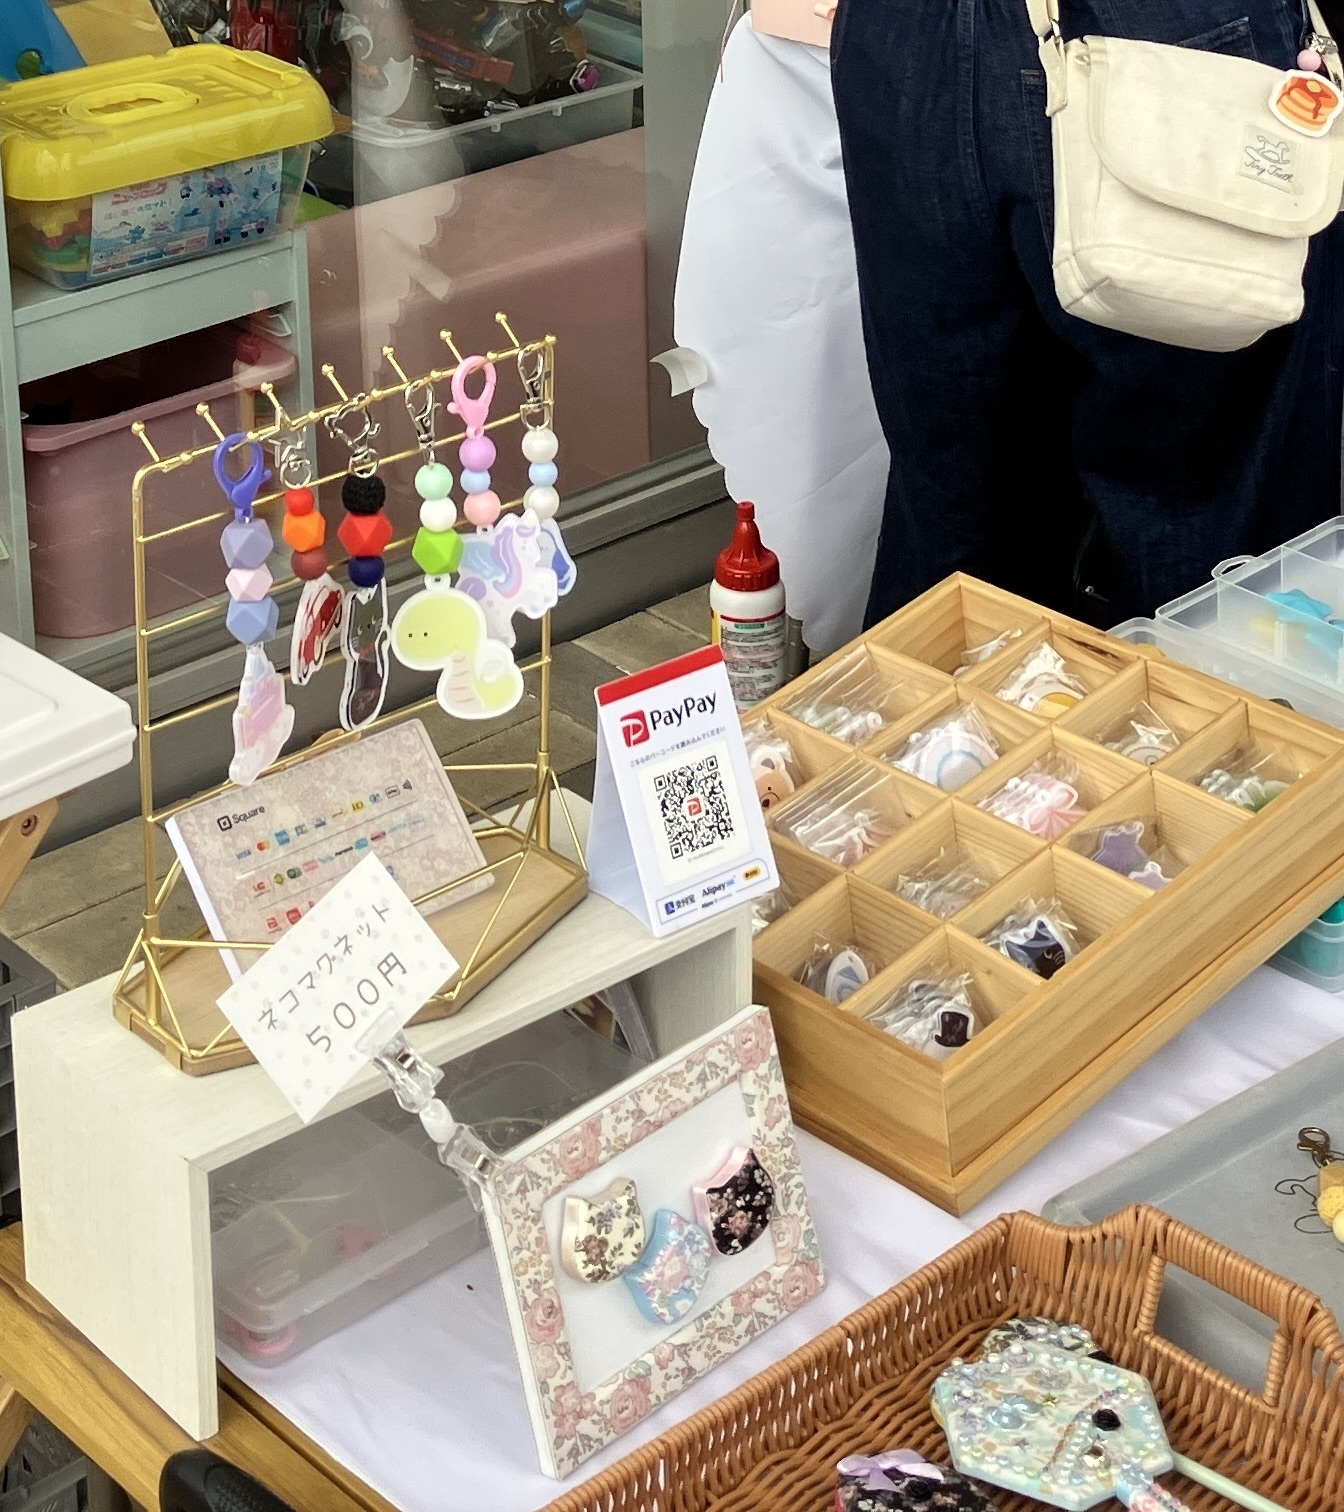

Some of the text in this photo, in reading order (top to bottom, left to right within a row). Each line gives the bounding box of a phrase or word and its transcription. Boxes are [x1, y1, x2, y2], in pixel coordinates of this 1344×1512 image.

[649, 691, 718, 732] PayPay
[231, 805, 266, 826] Square
[257, 901, 391, 1031] ネコマグネット
[306, 951, 407, 1054] 500円
